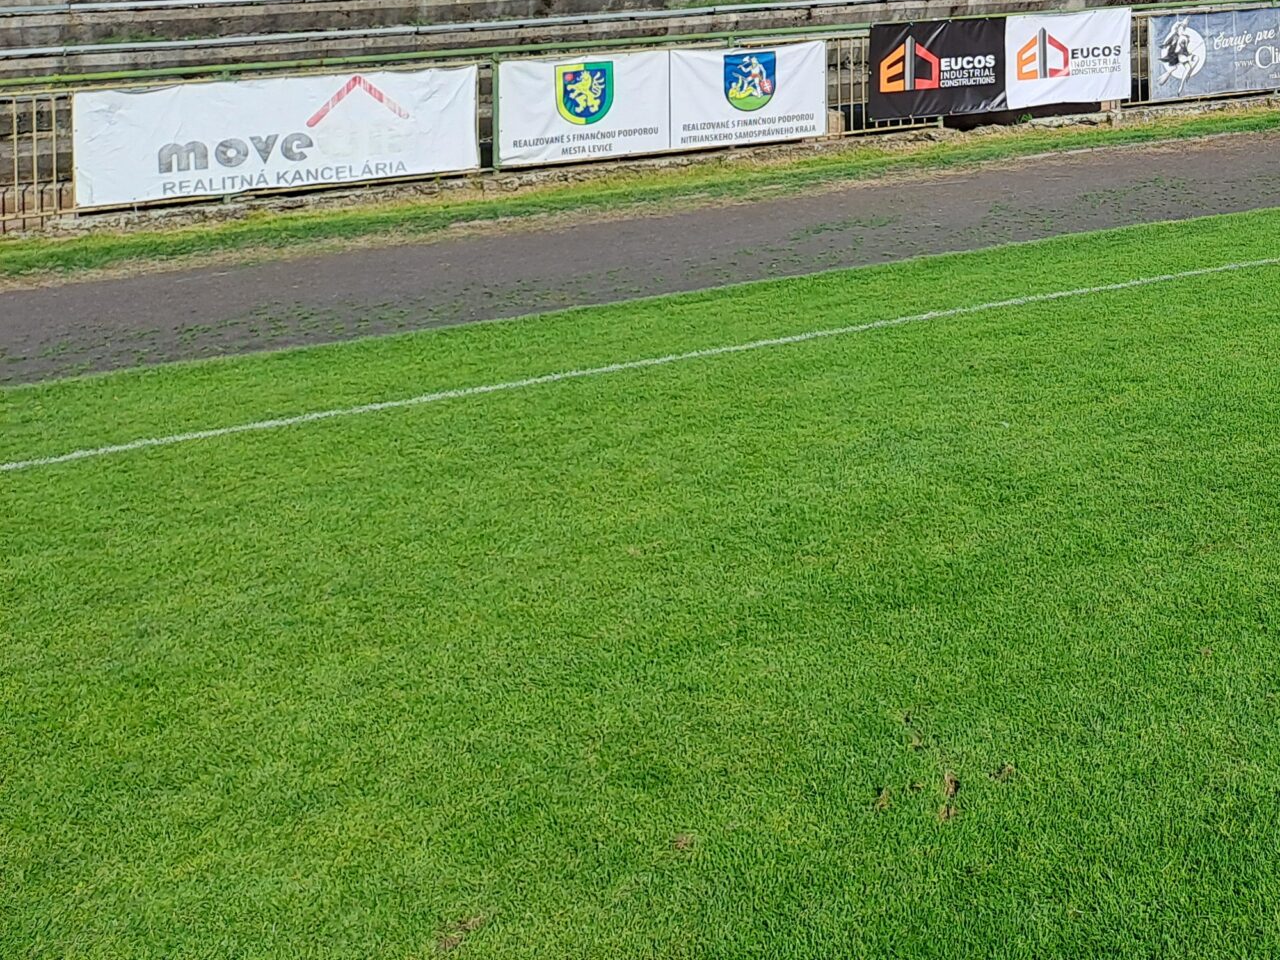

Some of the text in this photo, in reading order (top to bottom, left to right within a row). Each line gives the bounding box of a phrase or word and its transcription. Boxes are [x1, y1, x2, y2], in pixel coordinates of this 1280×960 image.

[1254, 28, 1275, 44] pre
[1071, 45, 1121, 59] EUCOS
[940, 55, 995, 71] EUCOS
[1071, 58, 1121, 68] INDUSTRIAL
[1071, 65, 1121, 76] CONSTRUCTIONS
[940, 68, 995, 80] INDUSTRIAL
[940, 76, 995, 88] CONSTRUCTIONS
[682, 113, 815, 132] REALIZOVANÉ S FINANČNOU PODPOROU
[513, 126, 659, 148] REALIZOVANÉ S FINANČNOU PODPOROU
[681, 124, 816, 144] NITRIANSKEHO SAMOSPRÁVNEHO KRAJA
[561, 143, 613, 156] MESTA LEVICE
[162, 160, 408, 196] REALITNÁ KANCELÁRIA
